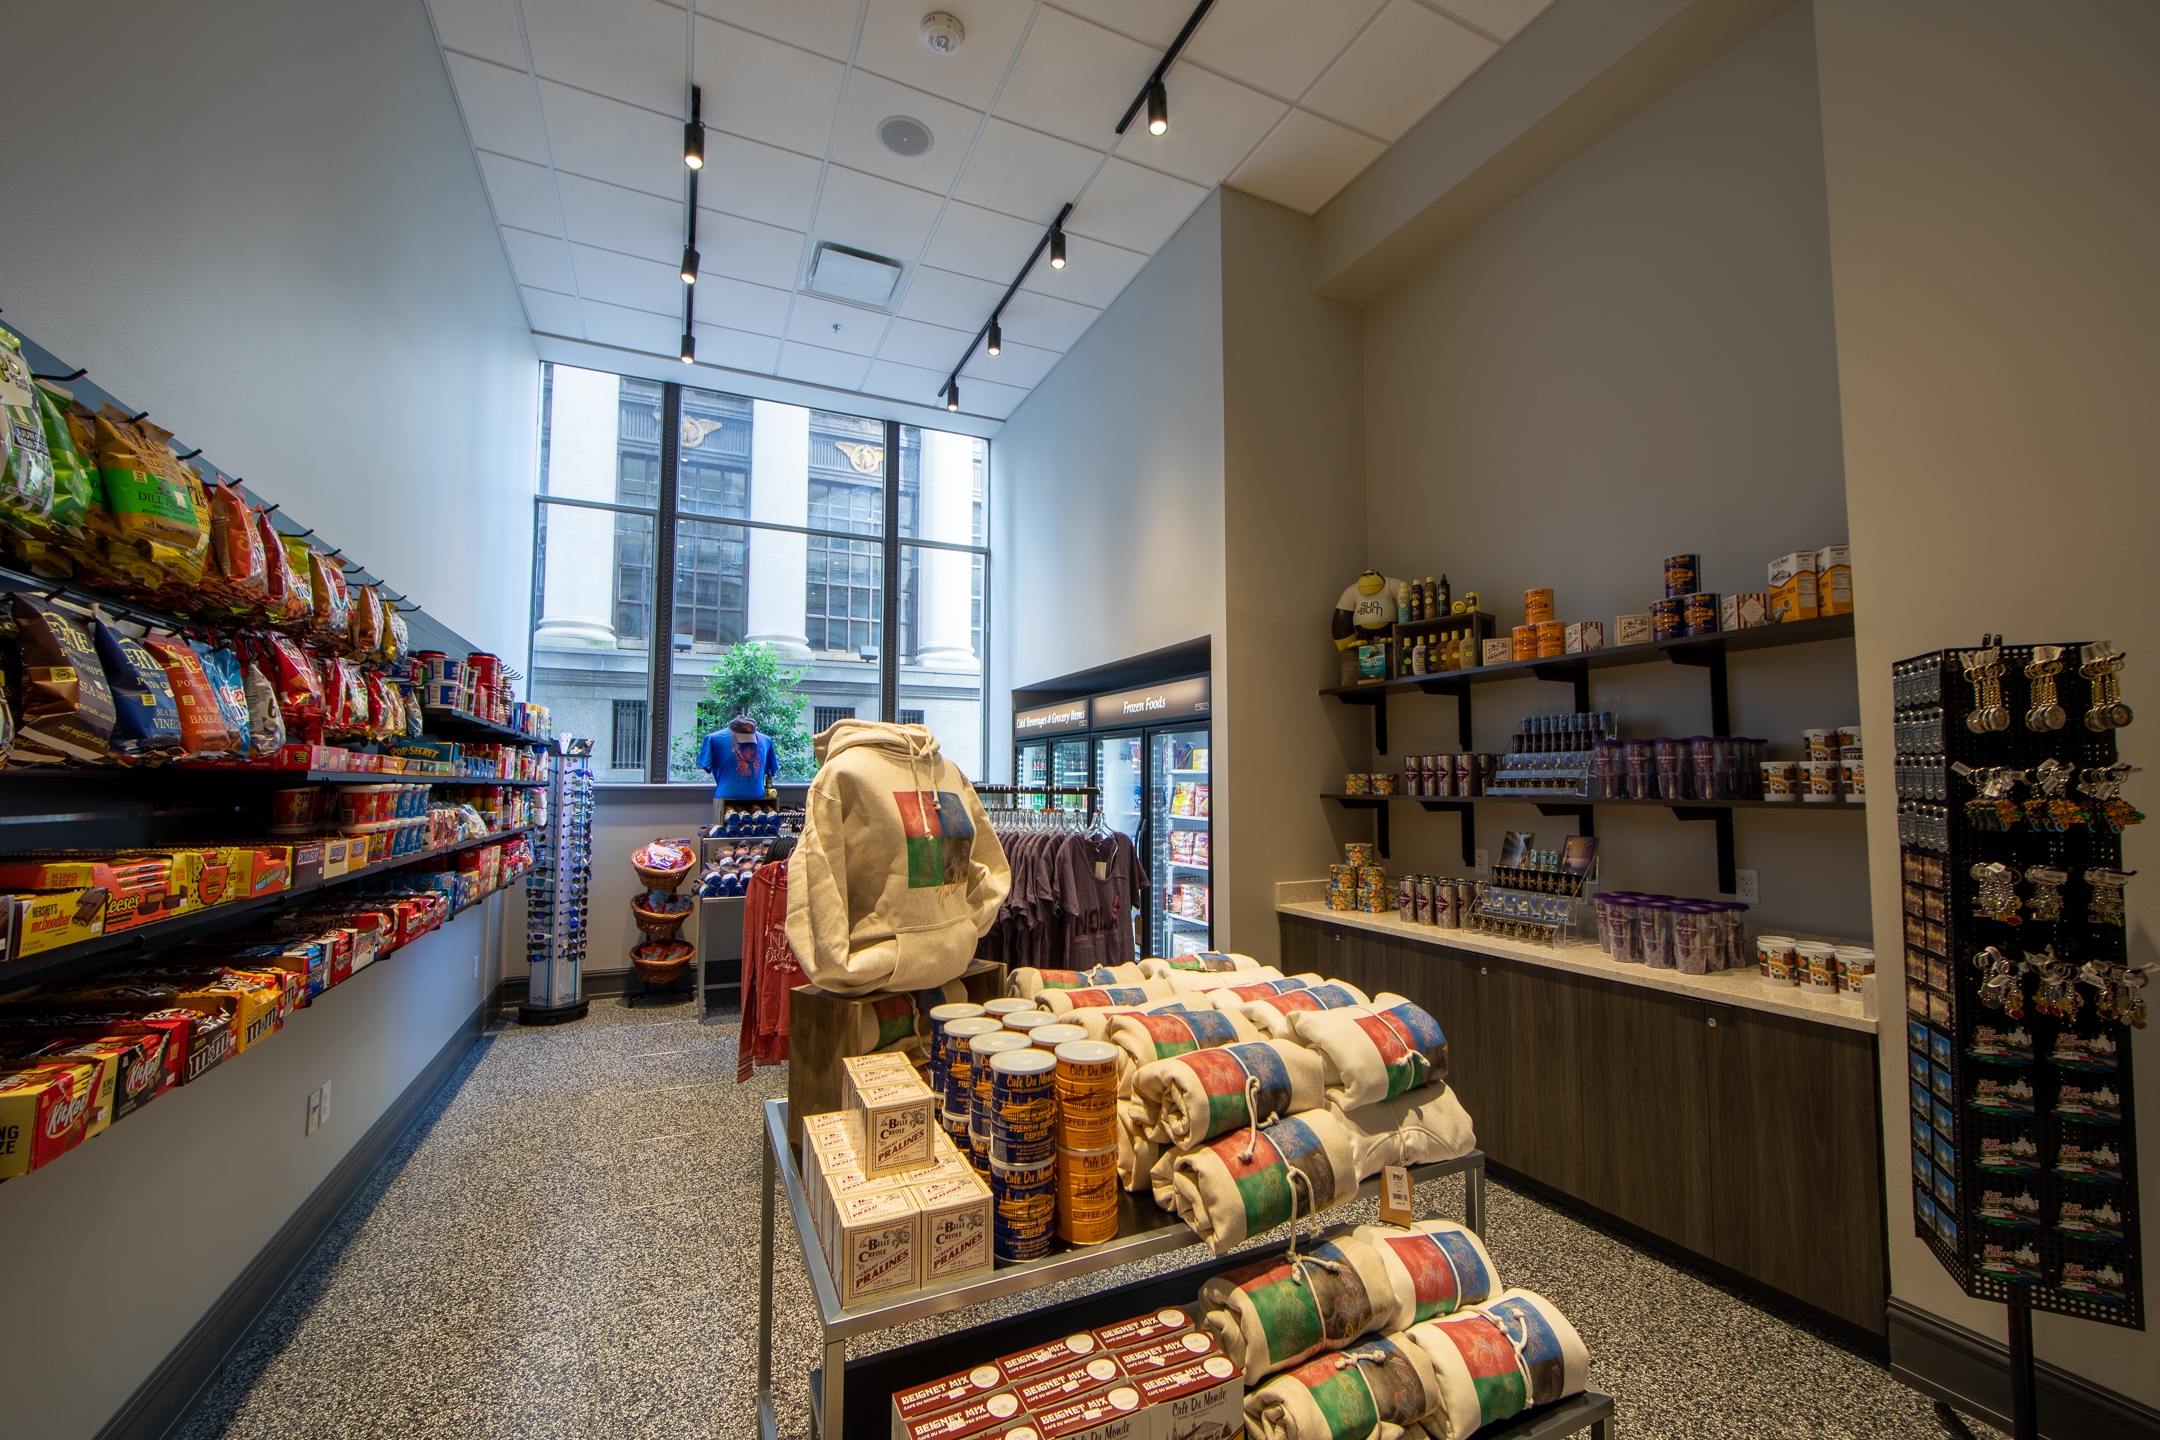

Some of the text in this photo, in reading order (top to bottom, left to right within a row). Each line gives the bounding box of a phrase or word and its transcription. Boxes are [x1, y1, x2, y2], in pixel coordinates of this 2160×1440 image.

[138, 491, 165, 507] DILL
[1361, 600, 1380, 609] sun
[1359, 606, 1383, 619] bum
[79, 681, 114, 706] SEA SALT
[157, 708, 168, 716] SEA
[1123, 696, 1167, 714] Frozen Foods
[1016, 718, 1026, 729] Cold
[1026, 713, 1047, 729] Beverages
[1051, 710, 1071, 724] Grocery
[1070, 709, 1086, 721] Items
[390, 745, 440, 760] POP SECRET
[298, 849, 319, 864] SNICKERS
[51, 872, 79, 881] KING
[51, 880, 78, 888] SIZE
[32, 903, 58, 919] HERSHEY'S
[1773, 972, 1787, 980] NEW
[1088, 1064, 1099, 1077] Du
[102, 1076, 115, 1090] KING
[1025, 1074, 1037, 1087] Du
[101, 1086, 113, 1098] SIZE
[1010, 1122, 1039, 1132] FRENCH
[1062, 1115, 1087, 1126] COFFEE
[880, 1128, 905, 1140] CREOLE
[1024, 1130, 1049, 1140] COFFEE
[877, 1129, 925, 1162] PRALINES
[1023, 1170, 1035, 1184] Du
[1073, 1210, 1100, 1219] COFFEE
[1008, 1219, 1037, 1230] FRENCH
[1022, 1225, 1047, 1237] COFFEE
[936, 1231, 962, 1244] CREOLE
[858, 1249, 887, 1263] CREOLE
[934, 1231, 983, 1270] PRALINES
[856, 1249, 909, 1289] PRALINES
[1100, 1315, 1159, 1339] BEIGNET MIX
[1004, 1342, 1067, 1369] BEIGNET MIX
[1122, 1340, 1184, 1364] BEIGNET MIX
[1023, 1368, 1088, 1397] BEIGNET MIX
[1142, 1365, 1205, 1392] BEIGNET MIX
[900, 1375, 970, 1406] BEIGNET MIX
[1039, 1391, 1046, 1399] DU
[916, 1398, 924, 1406] DU
[1172, 1402, 1189, 1418] Café
[1191, 1397, 1202, 1411] Du
[1204, 1387, 1227, 1408] Monde
[1040, 1396, 1108, 1426] BEIGNET MIX
[914, 1403, 988, 1436] BEIGNET MIX
[1056, 1418, 1064, 1427] DU
[1104, 1420, 1131, 1439] Monde
